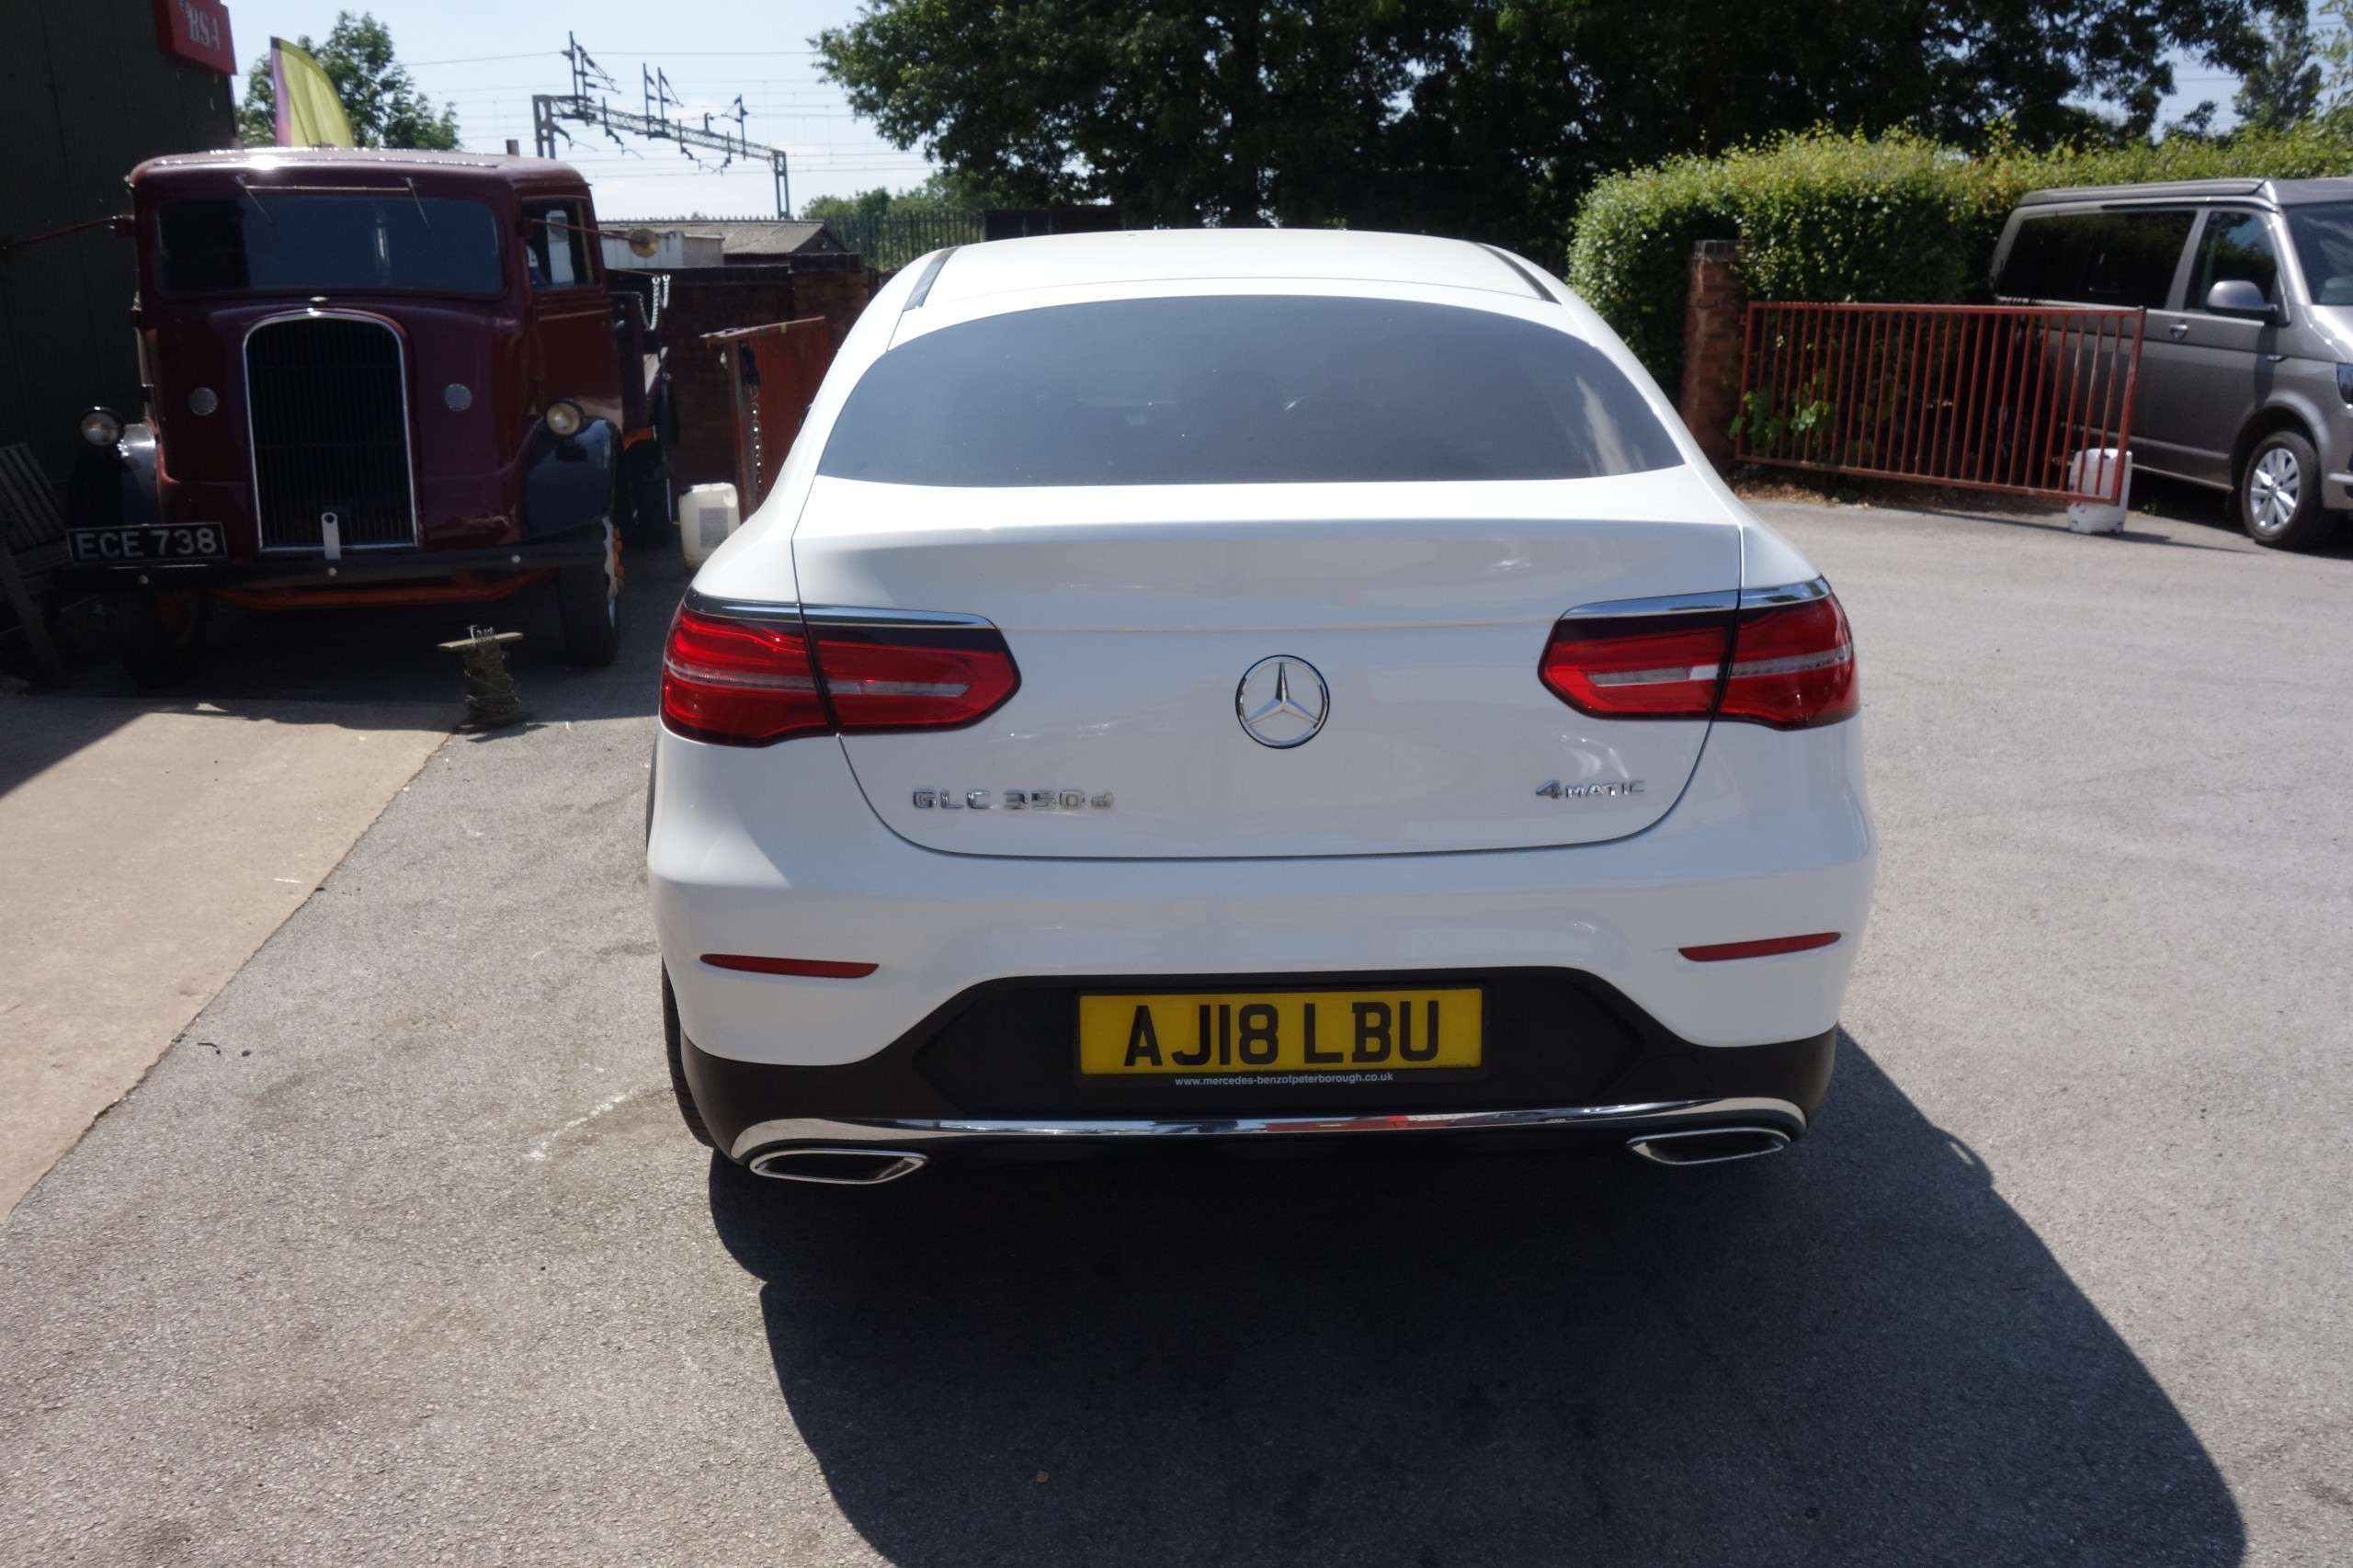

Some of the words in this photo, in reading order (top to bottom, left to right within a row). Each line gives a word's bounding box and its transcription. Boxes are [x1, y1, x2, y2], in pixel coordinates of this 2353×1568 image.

[75, 531, 143, 559] ECE
[150, 528, 217, 555] 738
[913, 790, 991, 810] GLC
[1536, 779, 1645, 800] 4MATIC
[1123, 1004, 1279, 1067] AJ18
[1303, 1000, 1439, 1063] LBU
[1175, 1073, 1393, 1086] www.mercedes-benzofpeterborough.co.uk
